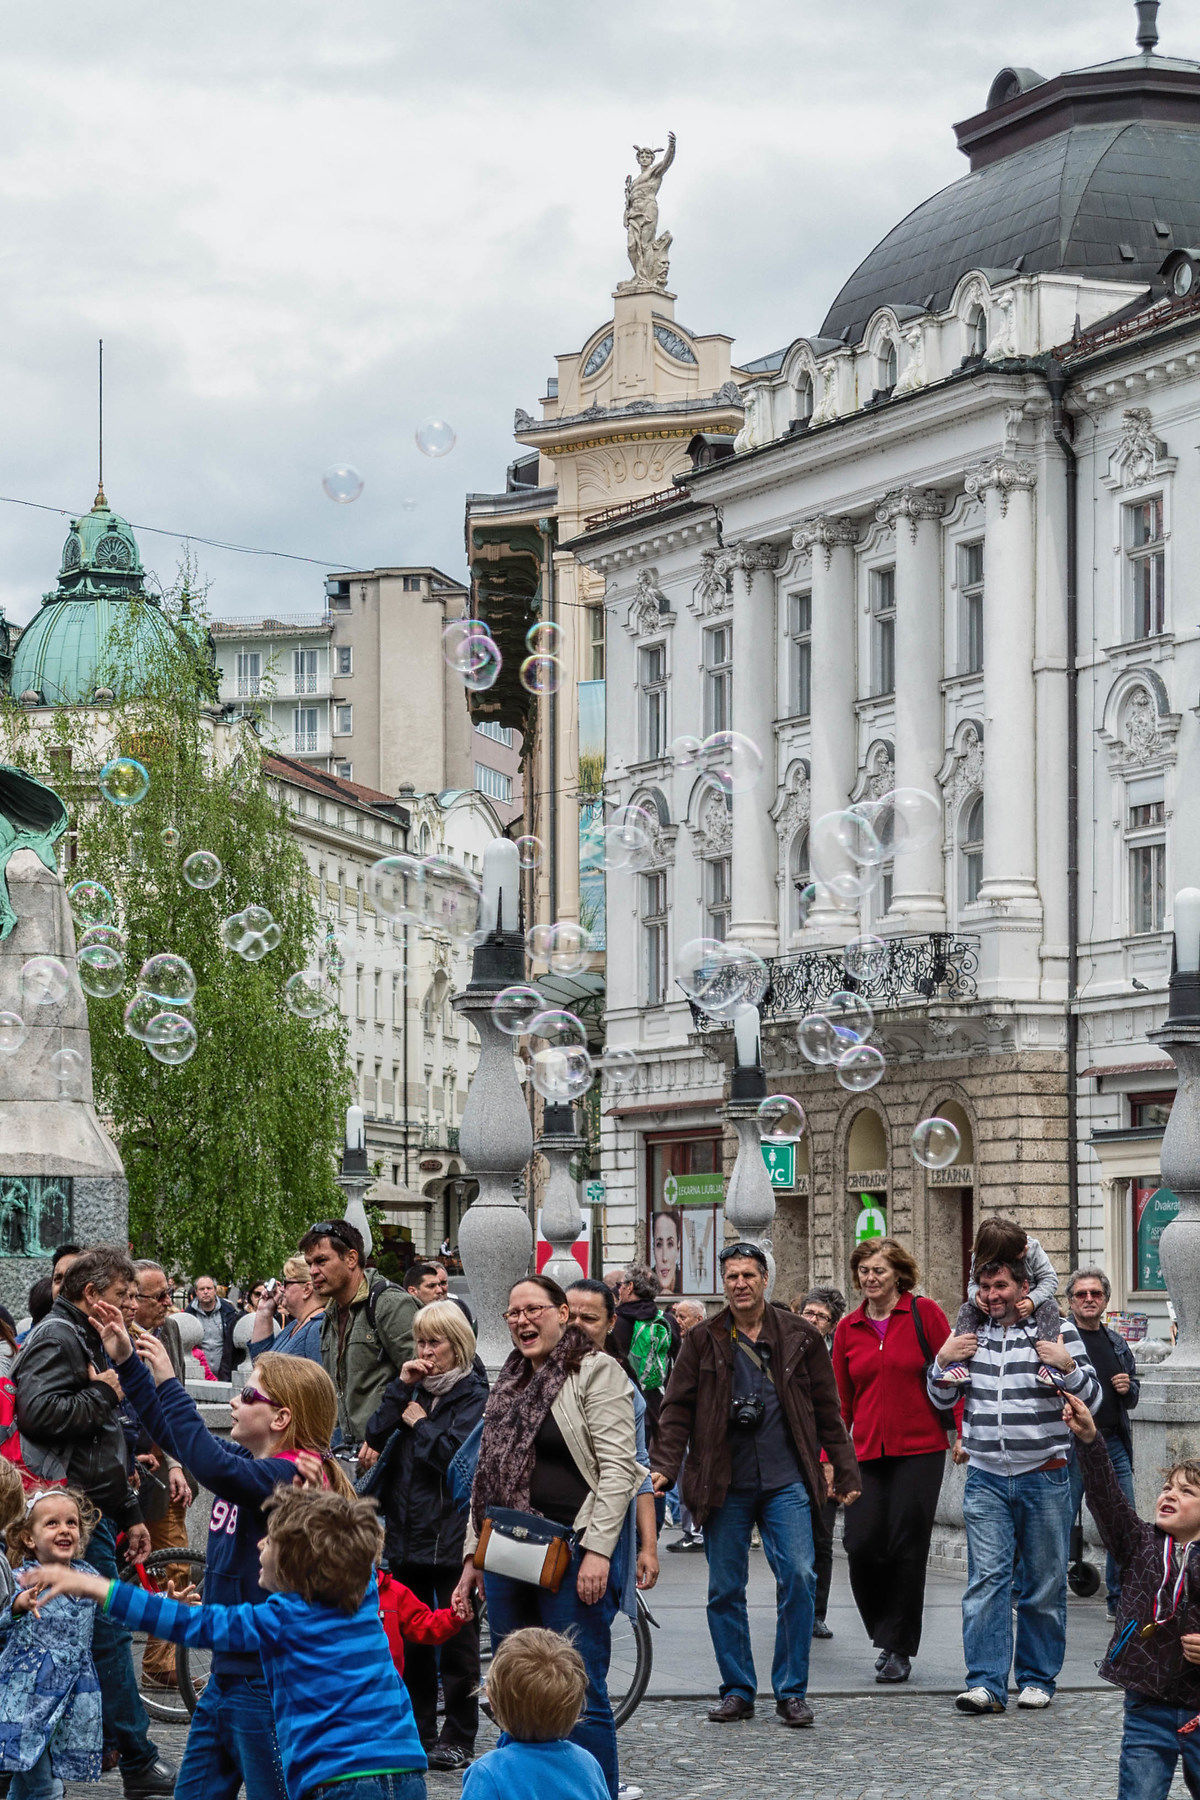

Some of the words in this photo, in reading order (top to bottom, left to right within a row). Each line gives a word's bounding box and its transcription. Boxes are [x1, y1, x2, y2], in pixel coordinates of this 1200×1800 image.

[603, 458, 665, 488] 1903
[930, 1168, 973, 1184] LEKARNA
[209, 1499, 239, 1535] 98
